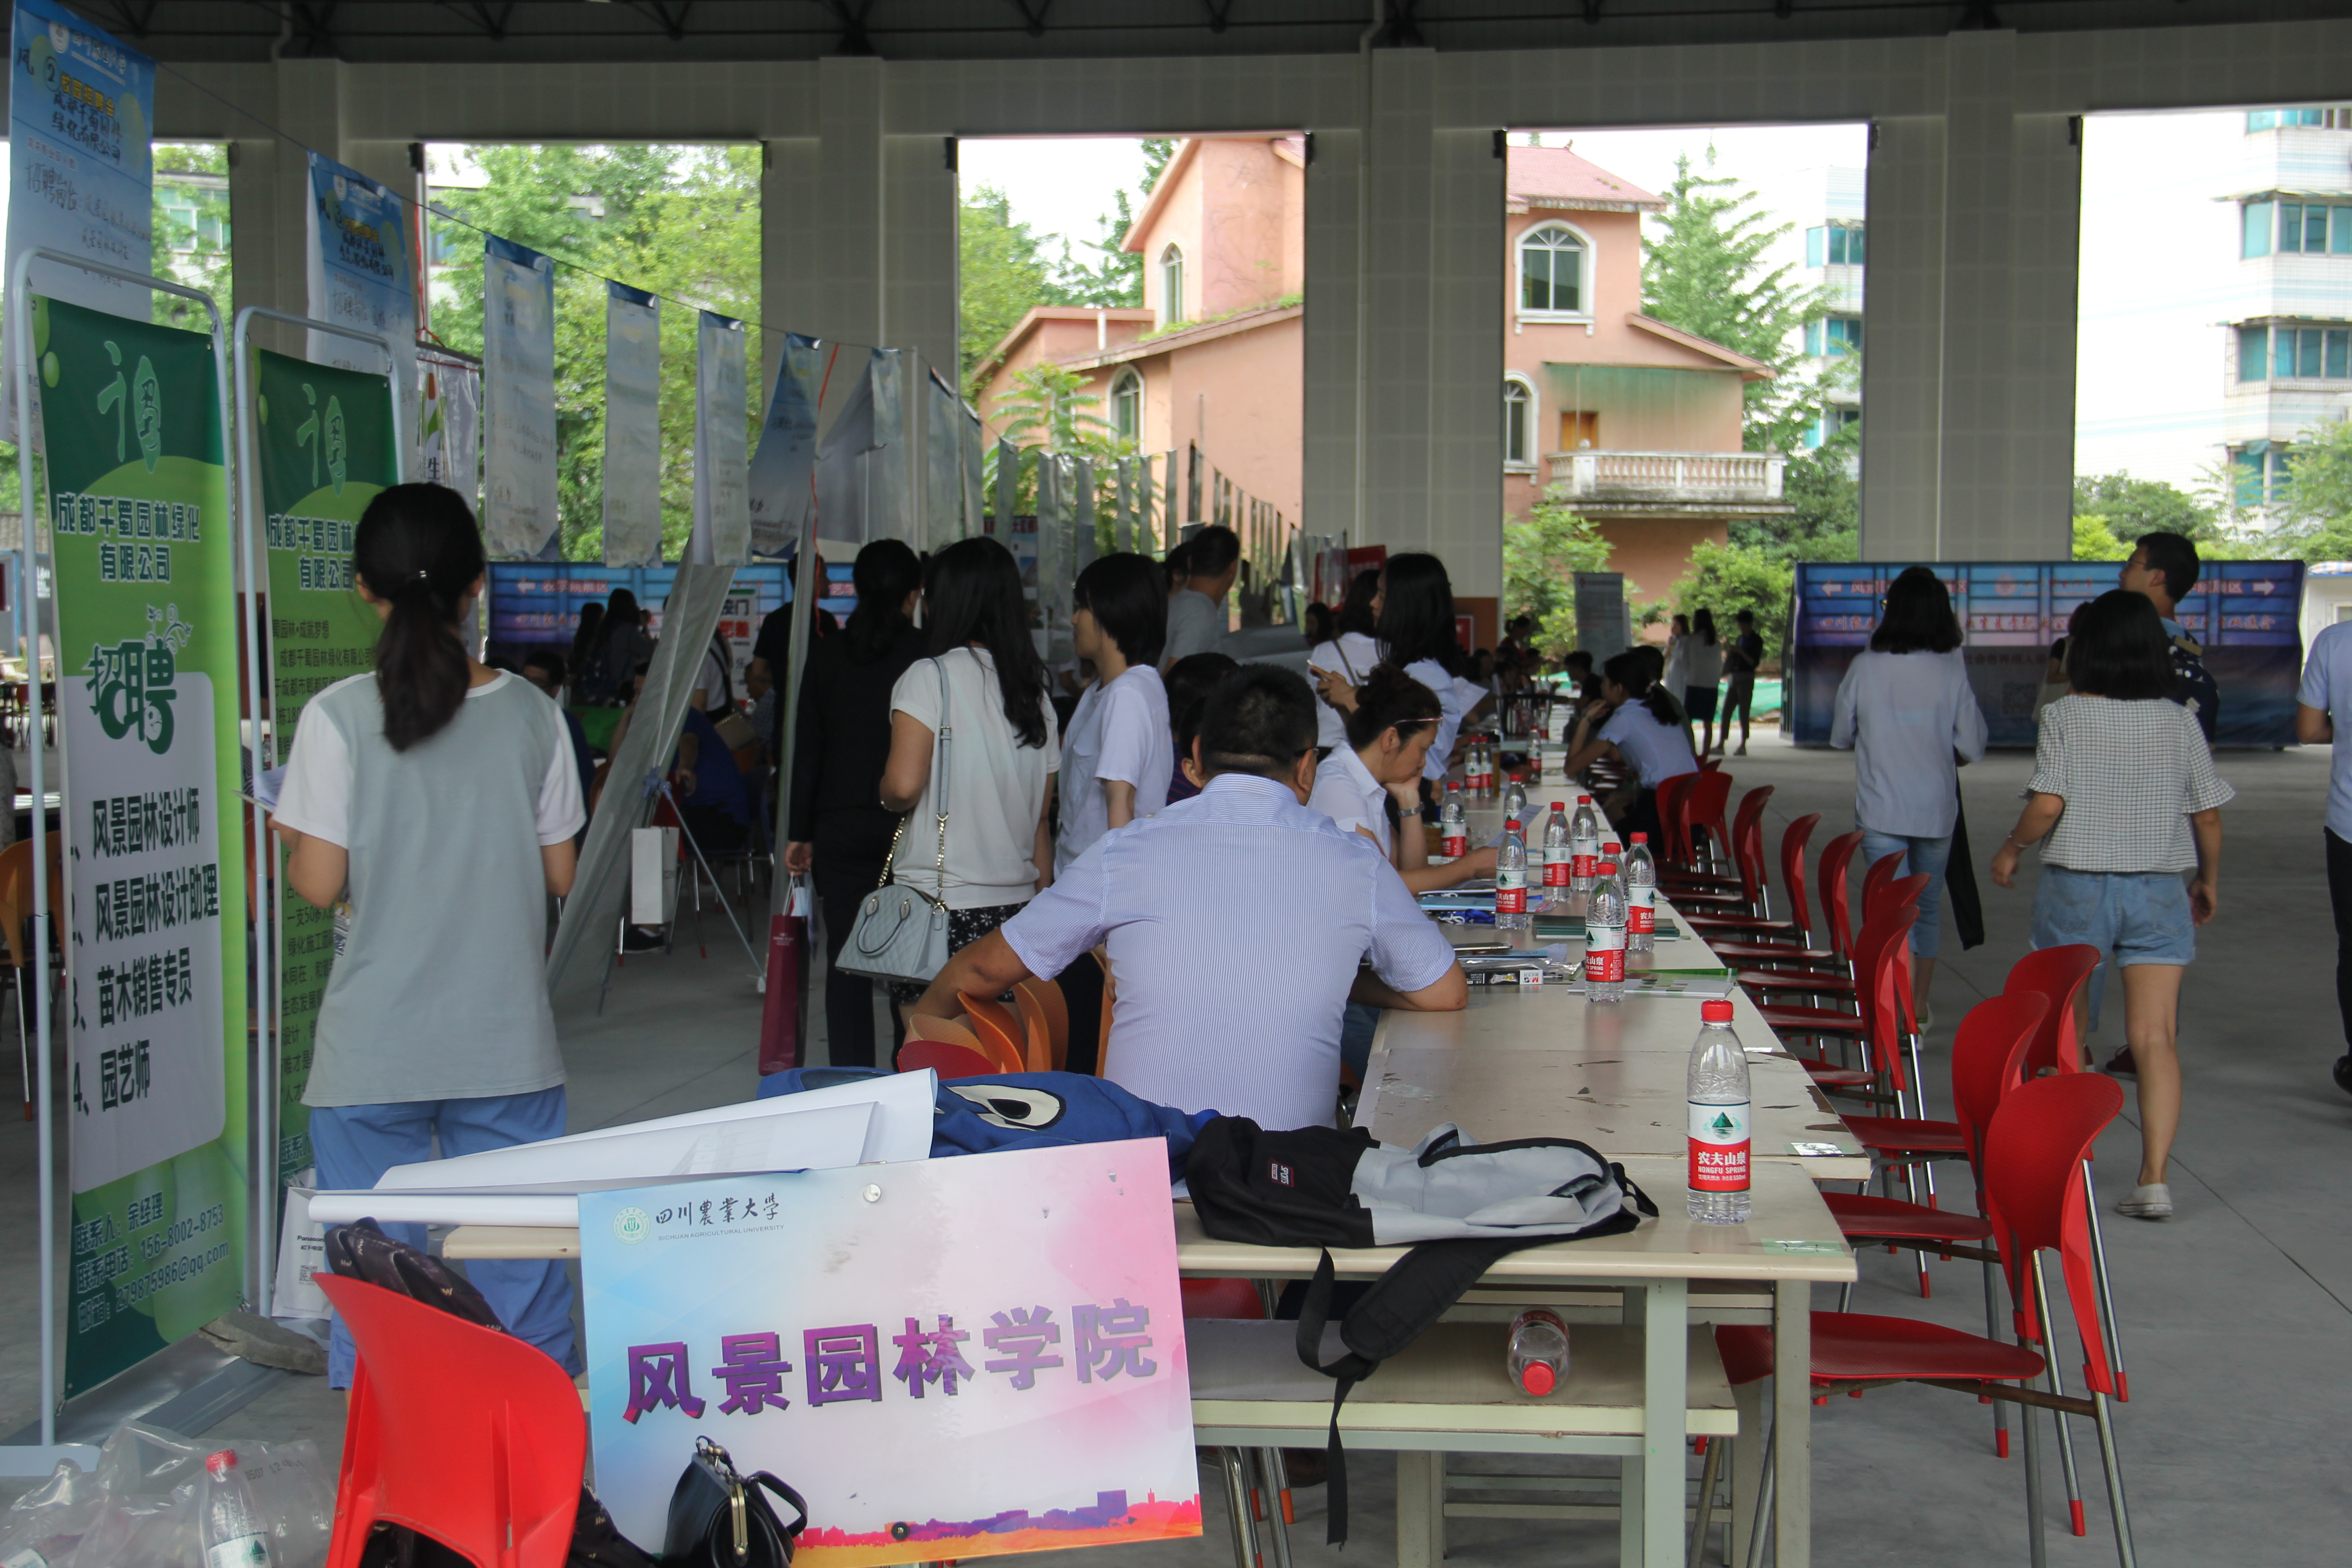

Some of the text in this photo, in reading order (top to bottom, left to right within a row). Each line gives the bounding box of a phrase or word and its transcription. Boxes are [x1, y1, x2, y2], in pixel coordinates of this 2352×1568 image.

[56, 491, 201, 543] 成都千蜀园林绿化
[269, 513, 359, 555] 成都千蜀园林
[99, 541, 172, 584] 有限公司
[299, 555, 355, 592] 有限公司
[1850, 578, 1890, 594] 风景园
[86, 639, 177, 756] 招聘
[71, 787, 200, 860] 、风景园林设计师
[1280, 1165, 1289, 1185] SPORTS
[1697, 1151, 1746, 1166] 农夫山泉
[1698, 1165, 1746, 1174] NONGFU SPRING
[690, 1229, 743, 1238] AGRICULTURAL
[743, 1224, 785, 1233] UNIVERSITY
[622, 1297, 1158, 1425] 风景园林学院
